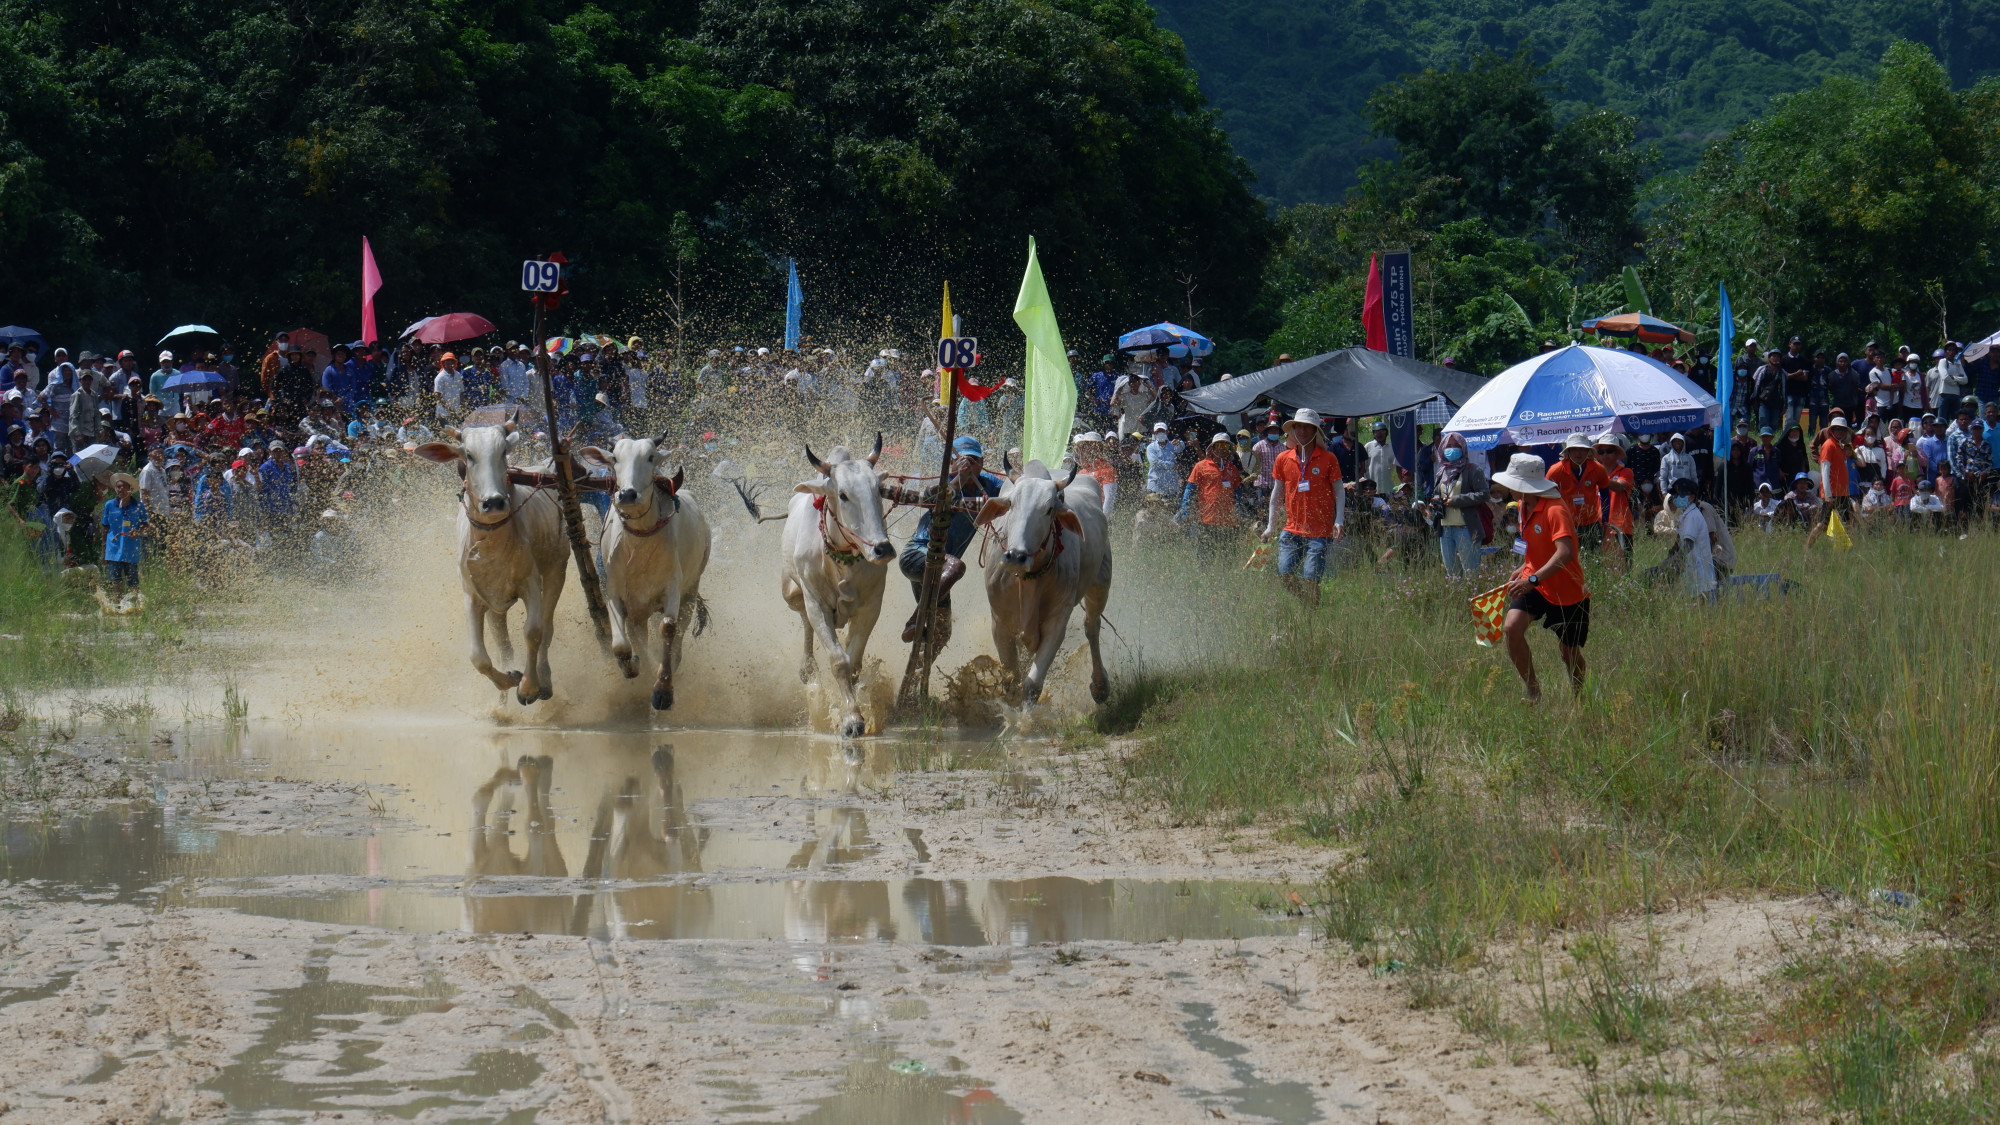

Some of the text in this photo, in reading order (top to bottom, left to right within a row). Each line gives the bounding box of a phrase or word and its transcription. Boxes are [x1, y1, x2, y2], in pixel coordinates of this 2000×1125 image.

[524, 261, 558, 291] 09
[1390, 266, 1398, 287] TP
[1390, 291, 1399, 322] 0.75
[939, 338, 975, 368] 08
[1537, 410, 1572, 418] Racumin
[1641, 416, 1671, 426] Racumin
[1672, 415, 1686, 423] 0.75
[1687, 414, 1697, 422] TP
[1537, 426, 1572, 436] Racumin
[1574, 425, 1592, 433] 0.75
